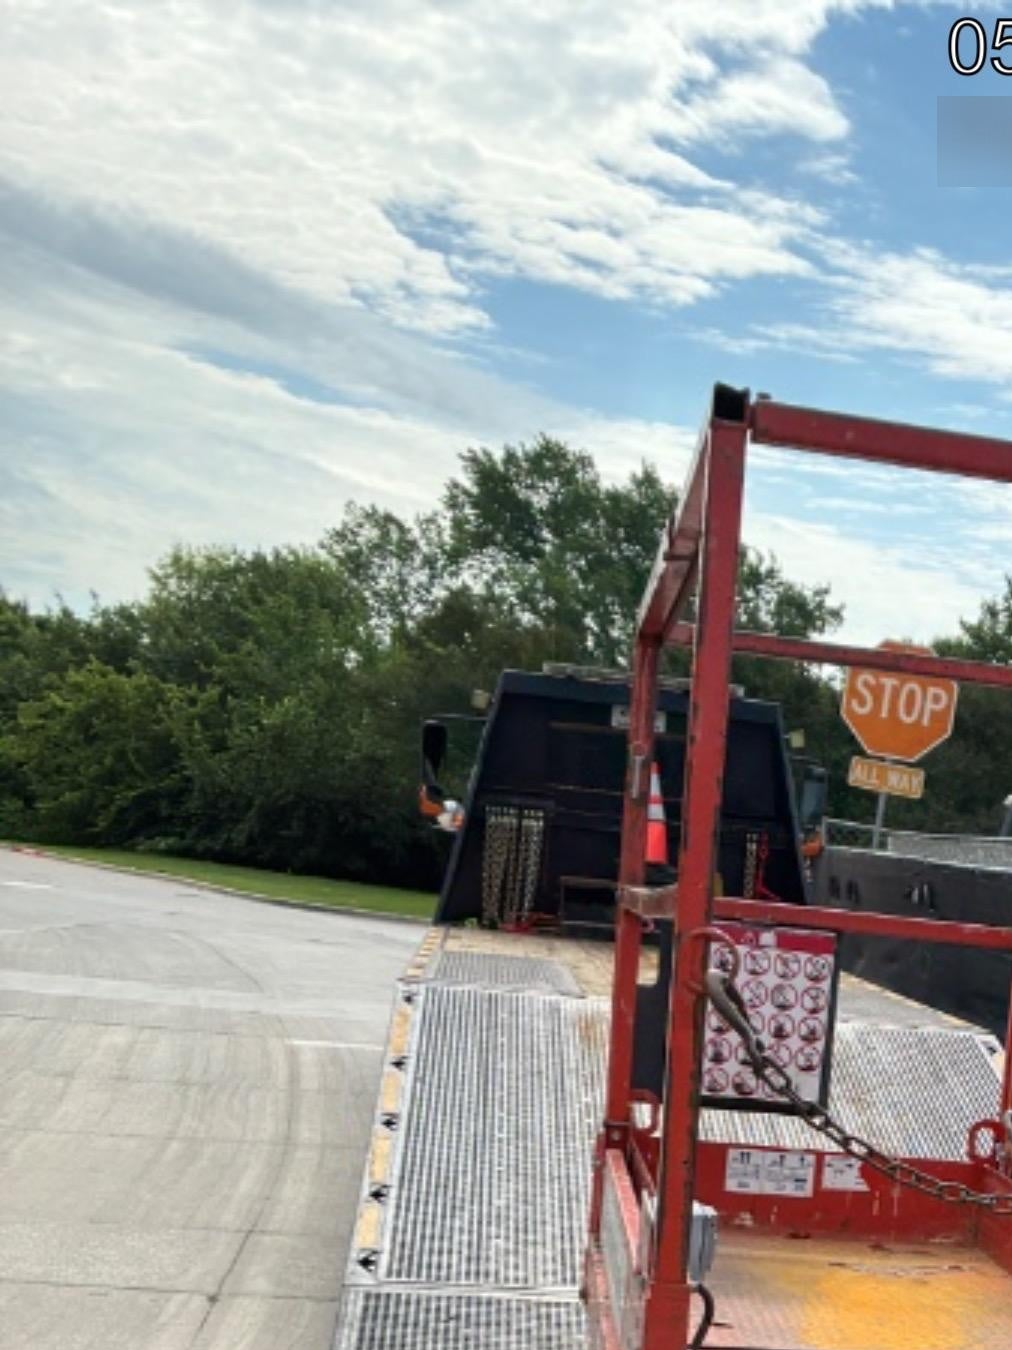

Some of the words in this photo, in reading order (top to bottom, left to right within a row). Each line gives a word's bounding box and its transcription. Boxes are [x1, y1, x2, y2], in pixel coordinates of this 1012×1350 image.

[851, 673, 949, 728] STOP
[852, 762, 881, 786] ALL
[887, 769, 923, 793] WAY
